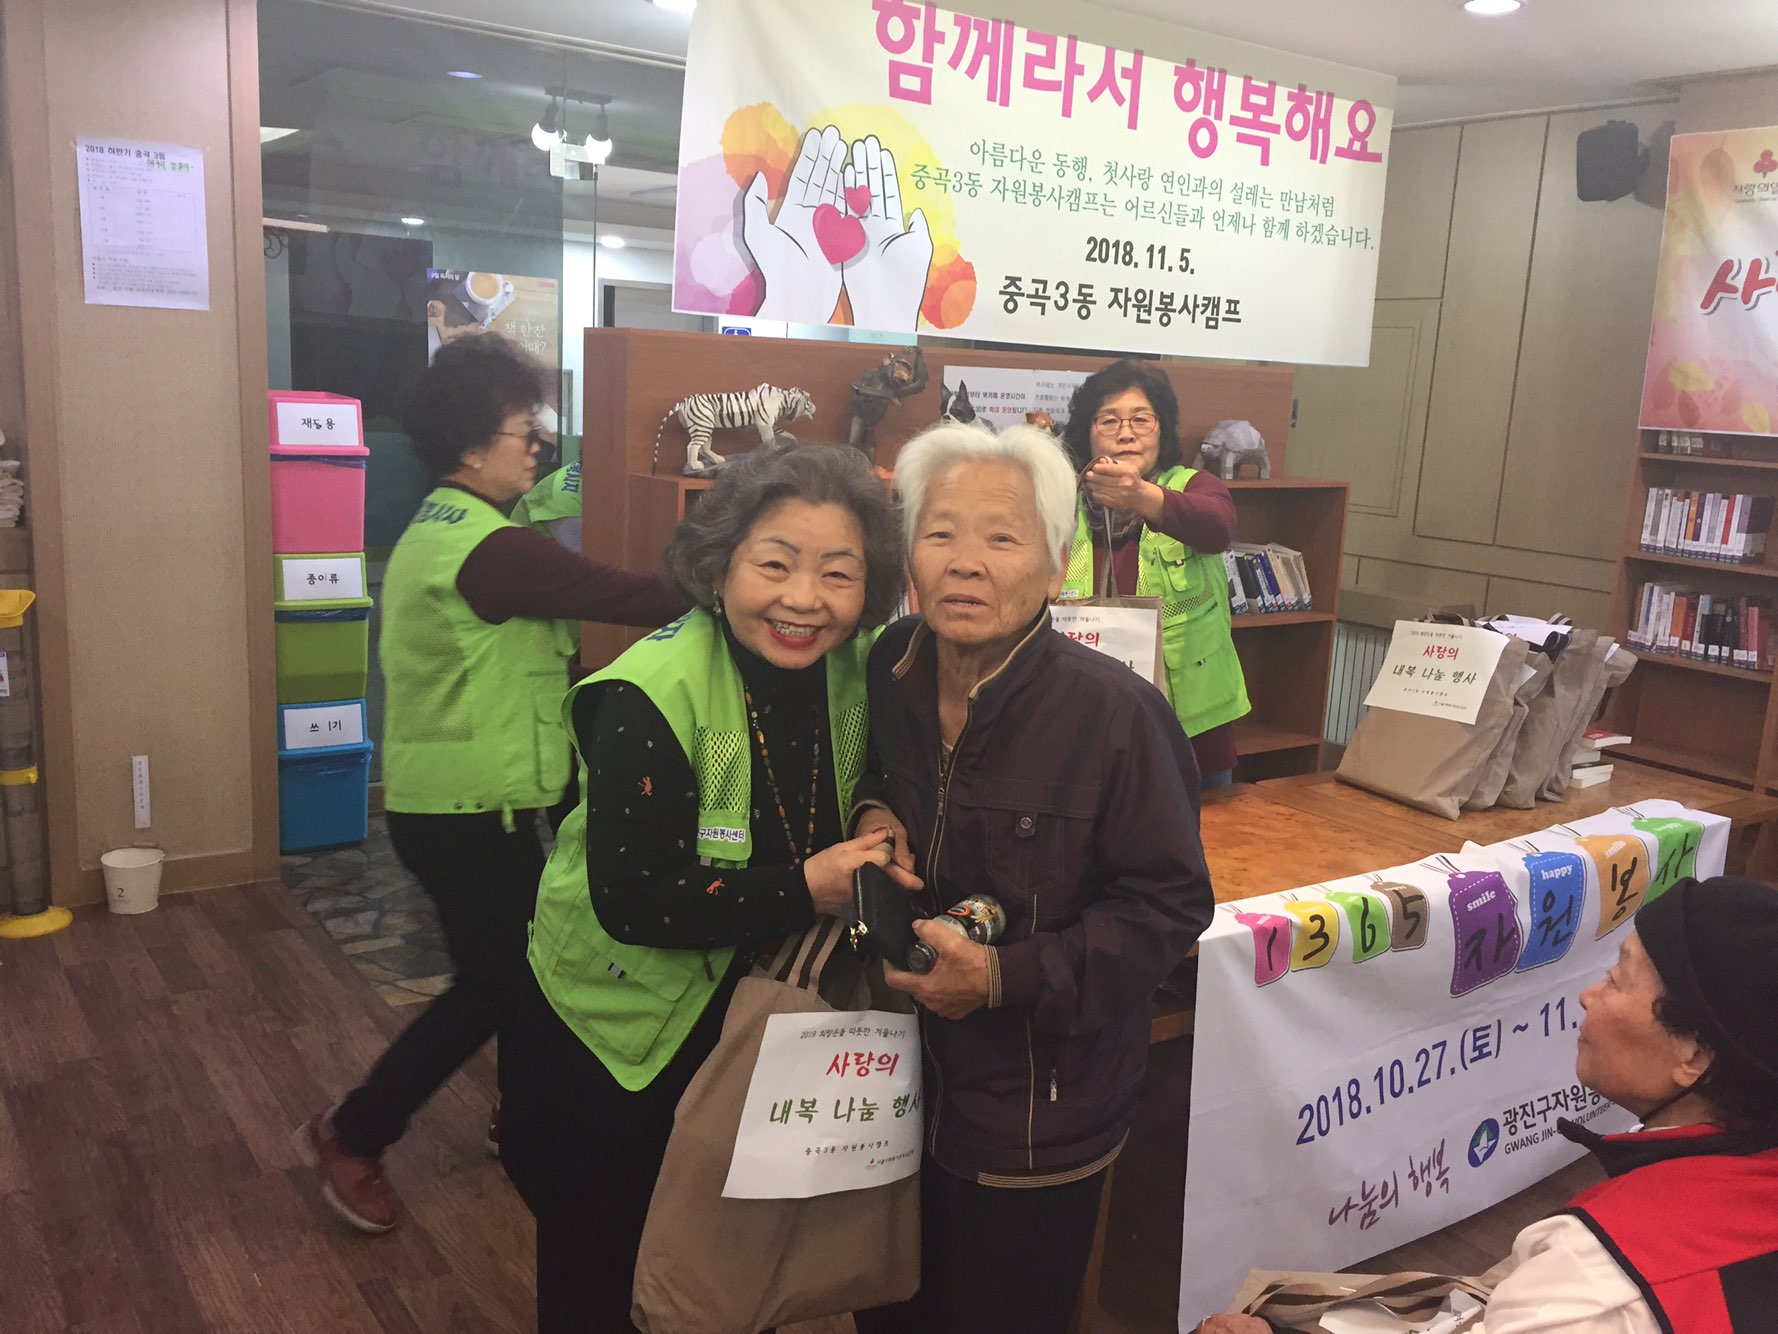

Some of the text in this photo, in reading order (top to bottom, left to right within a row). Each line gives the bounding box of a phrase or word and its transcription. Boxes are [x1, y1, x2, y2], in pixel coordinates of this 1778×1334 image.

[872, 0, 1382, 167] 함께라서 행복해요
[970, 139, 1046, 174] 아름다운
[1103, 160, 1154, 191] 첫사랑
[1160, 170, 1223, 202] 연인과의
[1229, 181, 1274, 209] 설레는
[1280, 189, 1335, 218] 만남처럼
[911, 163, 1375, 250] 중곡3동 자원봉사캠프는 어르신들과 언제나 함께 하겠습니다.
[999, 275, 1242, 330] 중곡3동 자원봉사캠프
[1422, 645, 1460, 661] 사랑의
[1392, 664, 1478, 685] 내복 나눔 행사
[1541, 863, 1573, 881] happy
[117, 887, 125, 898] 2
[1466, 889, 1497, 912] smile
[826, 1051, 900, 1078] 사랑의
[769, 1098, 819, 1126] 내복
[834, 1097, 880, 1123] 나눔
[1504, 1132, 1540, 1155] GWANG
[1328, 1138, 1450, 1231] 나눔의 행복
